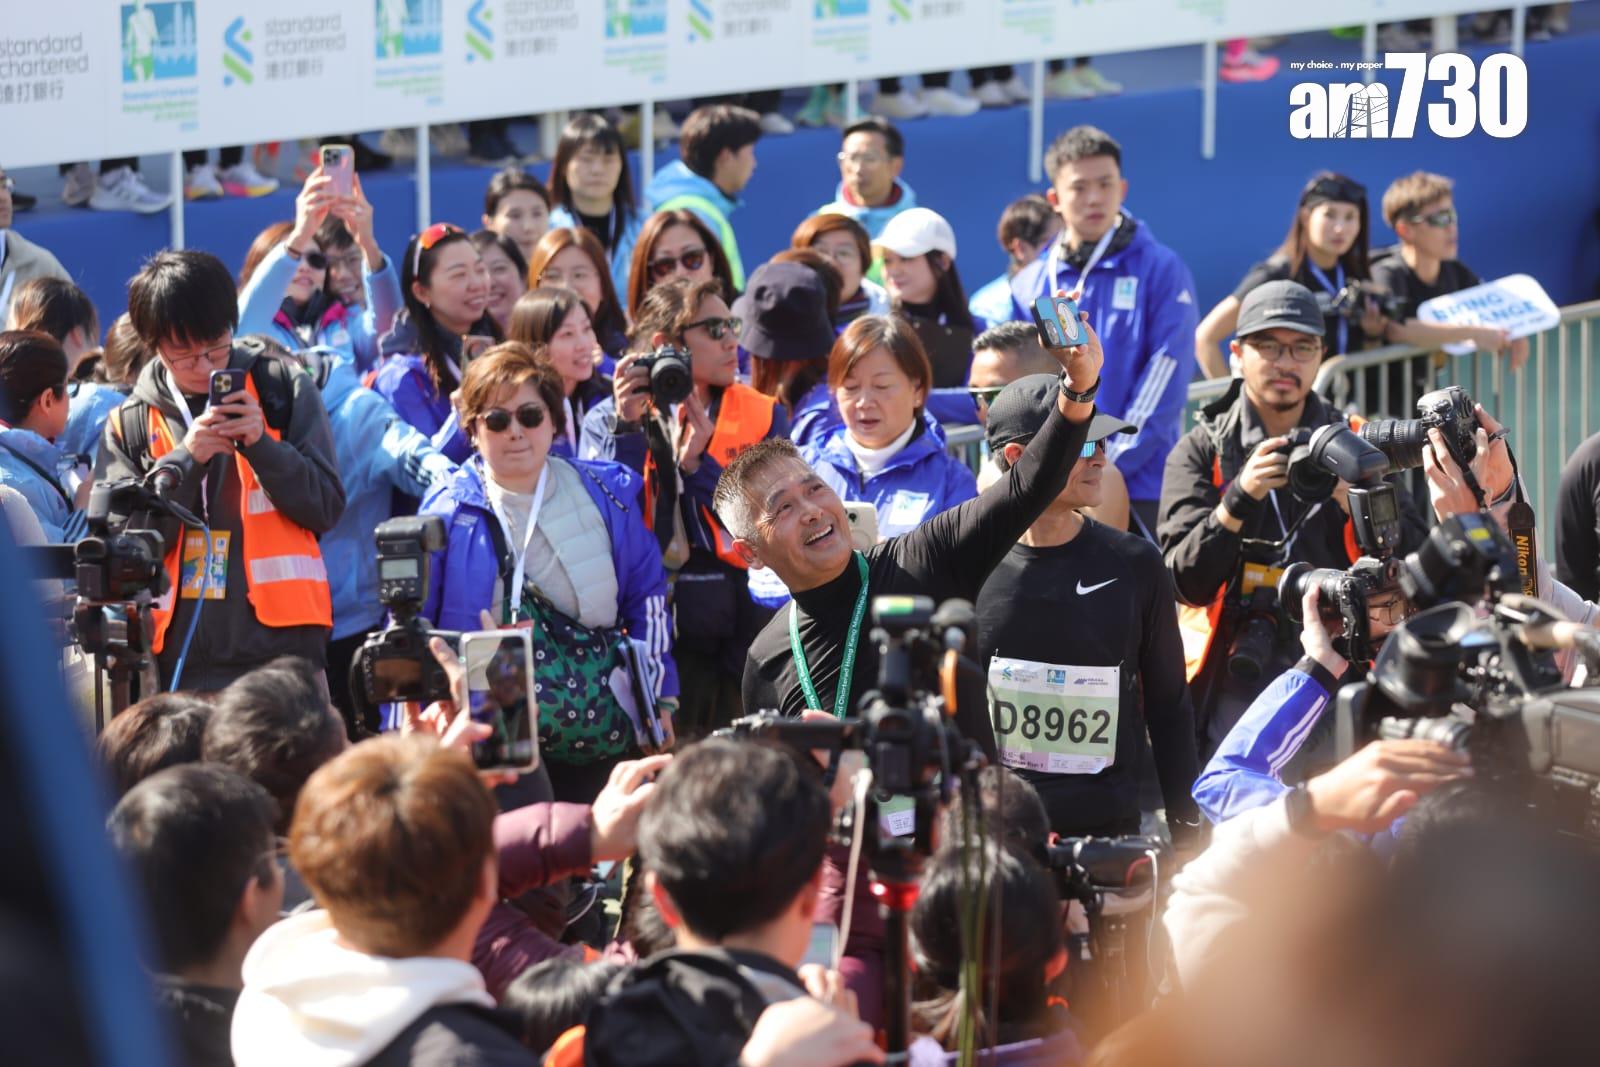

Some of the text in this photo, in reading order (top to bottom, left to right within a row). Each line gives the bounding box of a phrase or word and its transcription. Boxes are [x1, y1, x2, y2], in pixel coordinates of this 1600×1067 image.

[1516, 535, 1530, 576] Nikon
[848, 629, 857, 647] Kong
[845, 648, 854, 667] Hong
[838, 668, 849, 705] Chartered
[994, 700, 1111, 744] D8962
